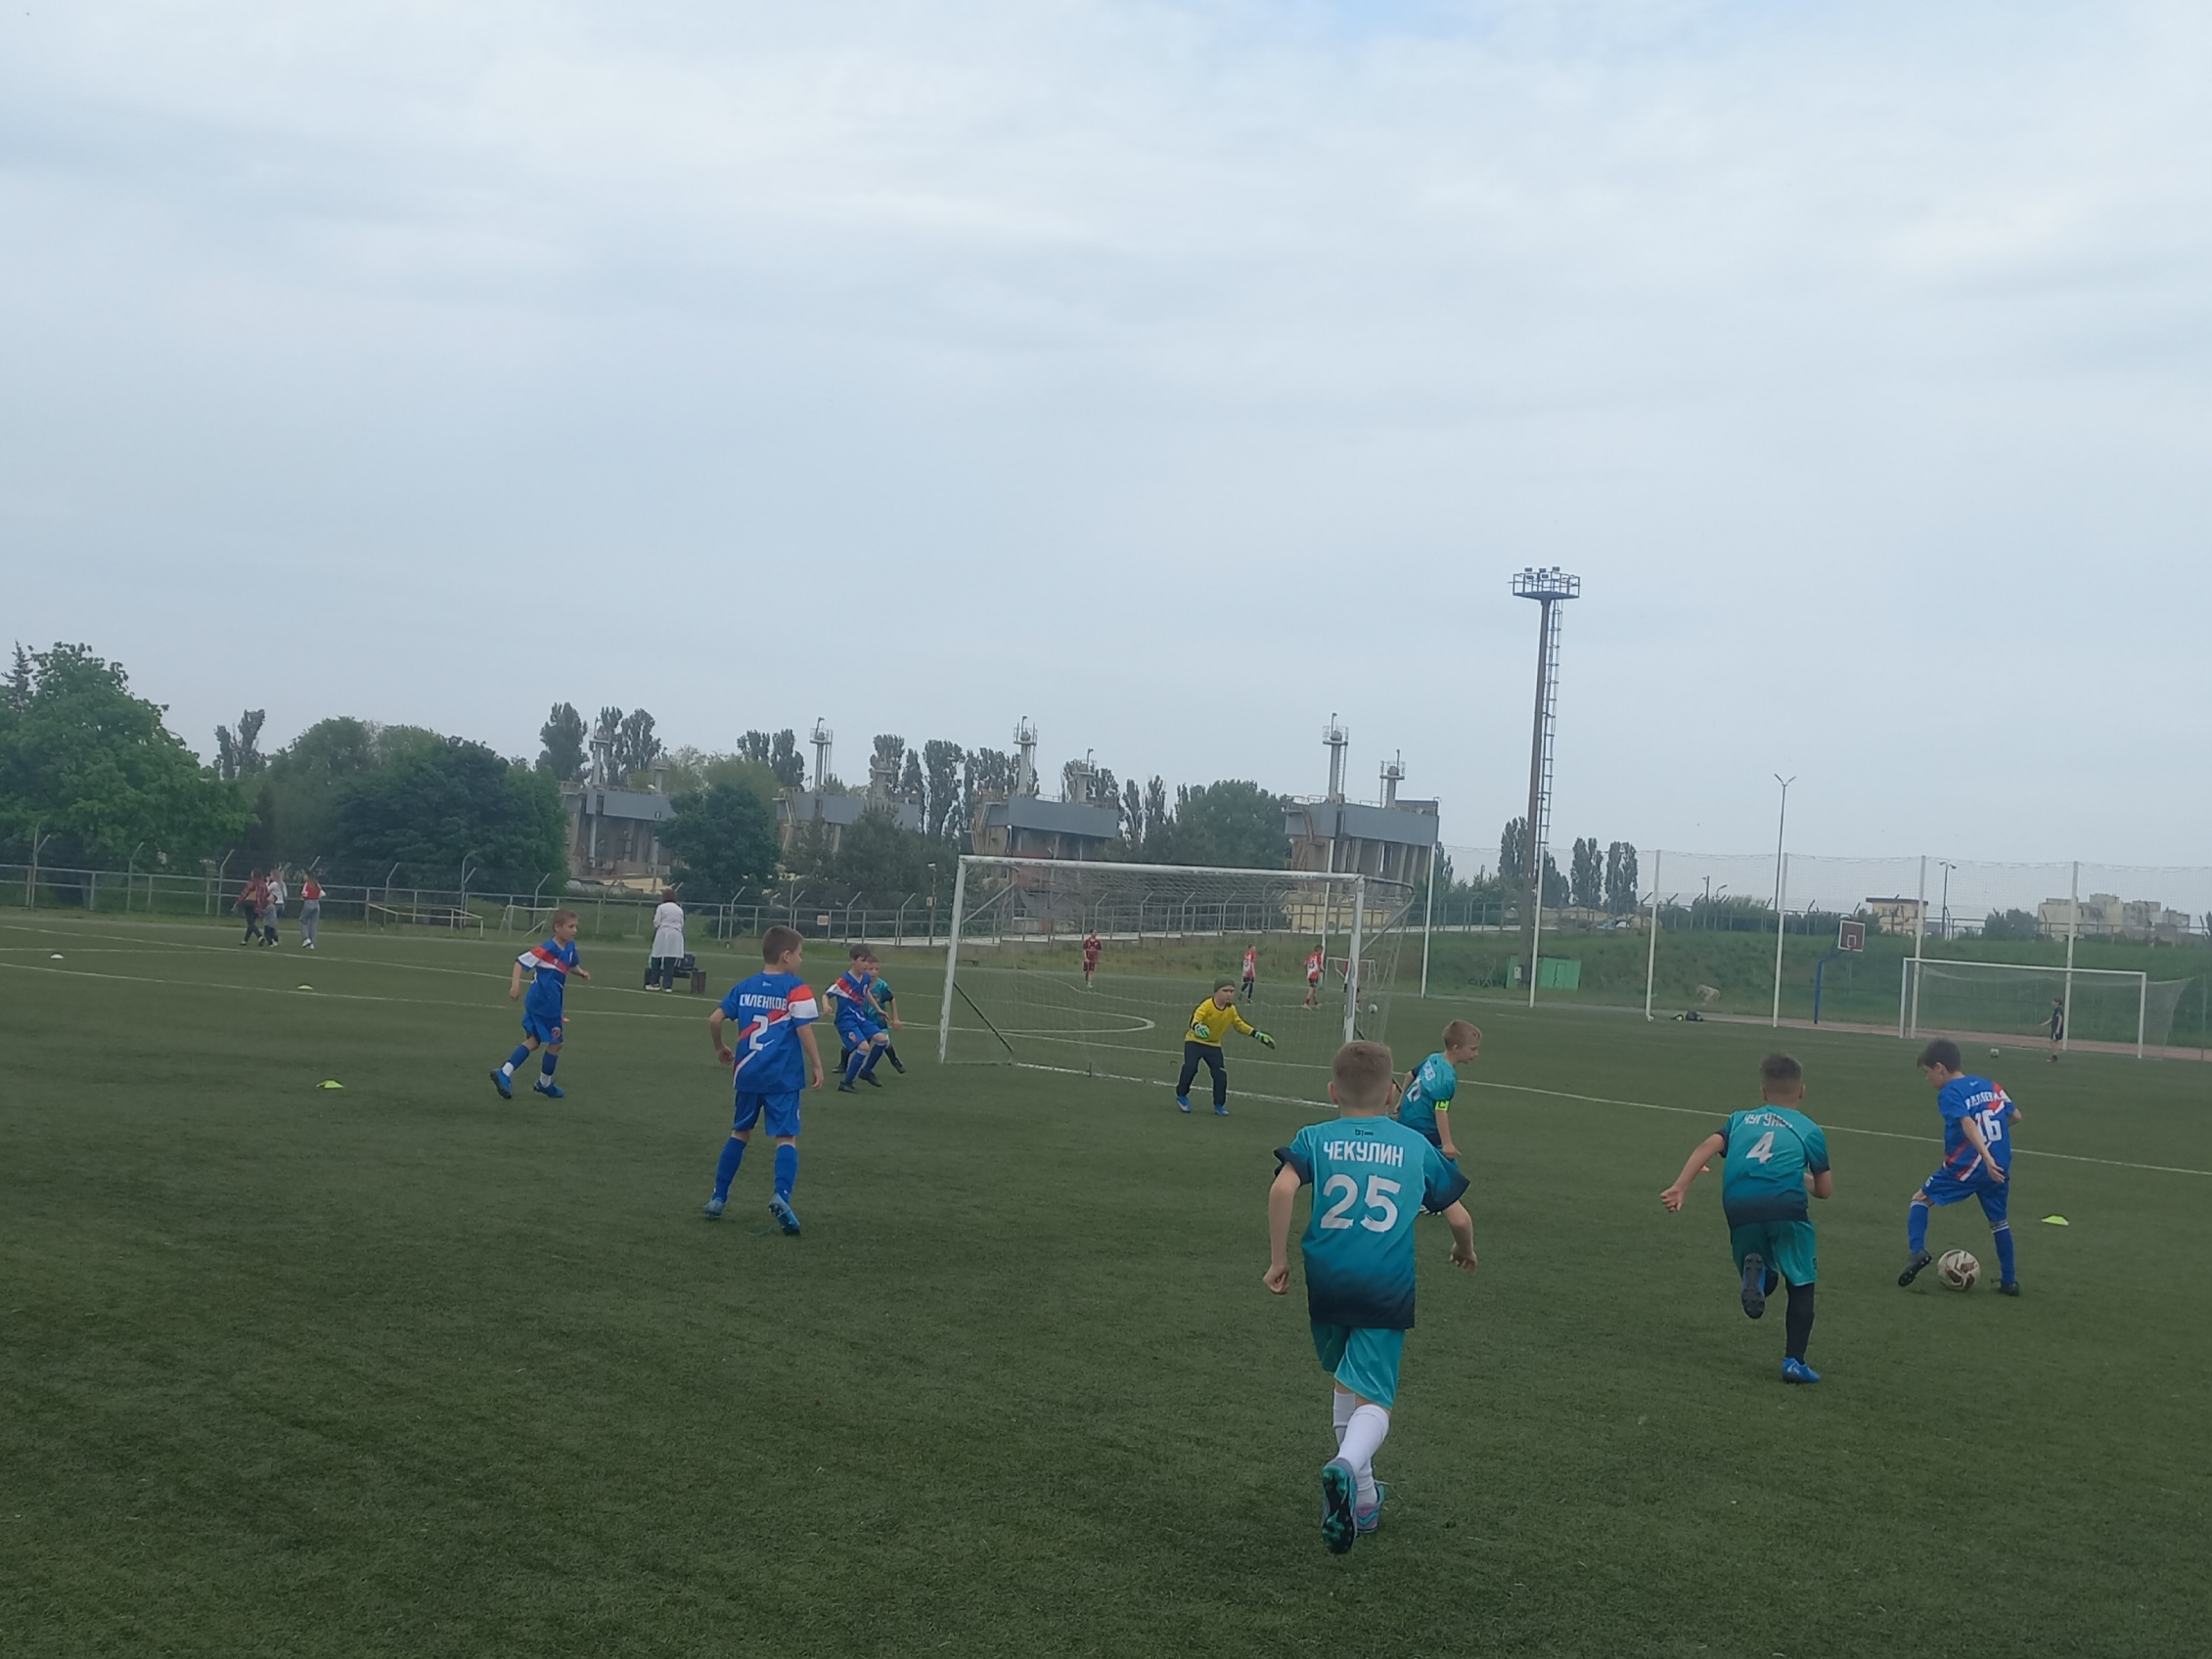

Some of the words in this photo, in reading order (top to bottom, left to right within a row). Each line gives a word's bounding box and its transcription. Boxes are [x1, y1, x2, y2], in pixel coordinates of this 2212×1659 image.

[749, 1014, 769, 1051] 2
[1975, 1109, 2003, 1143] 16
[1323, 1141, 1404, 1168] ЧЕКУЛИН
[1745, 1131, 1775, 1164] 4
[1320, 1174, 1401, 1233] 25
